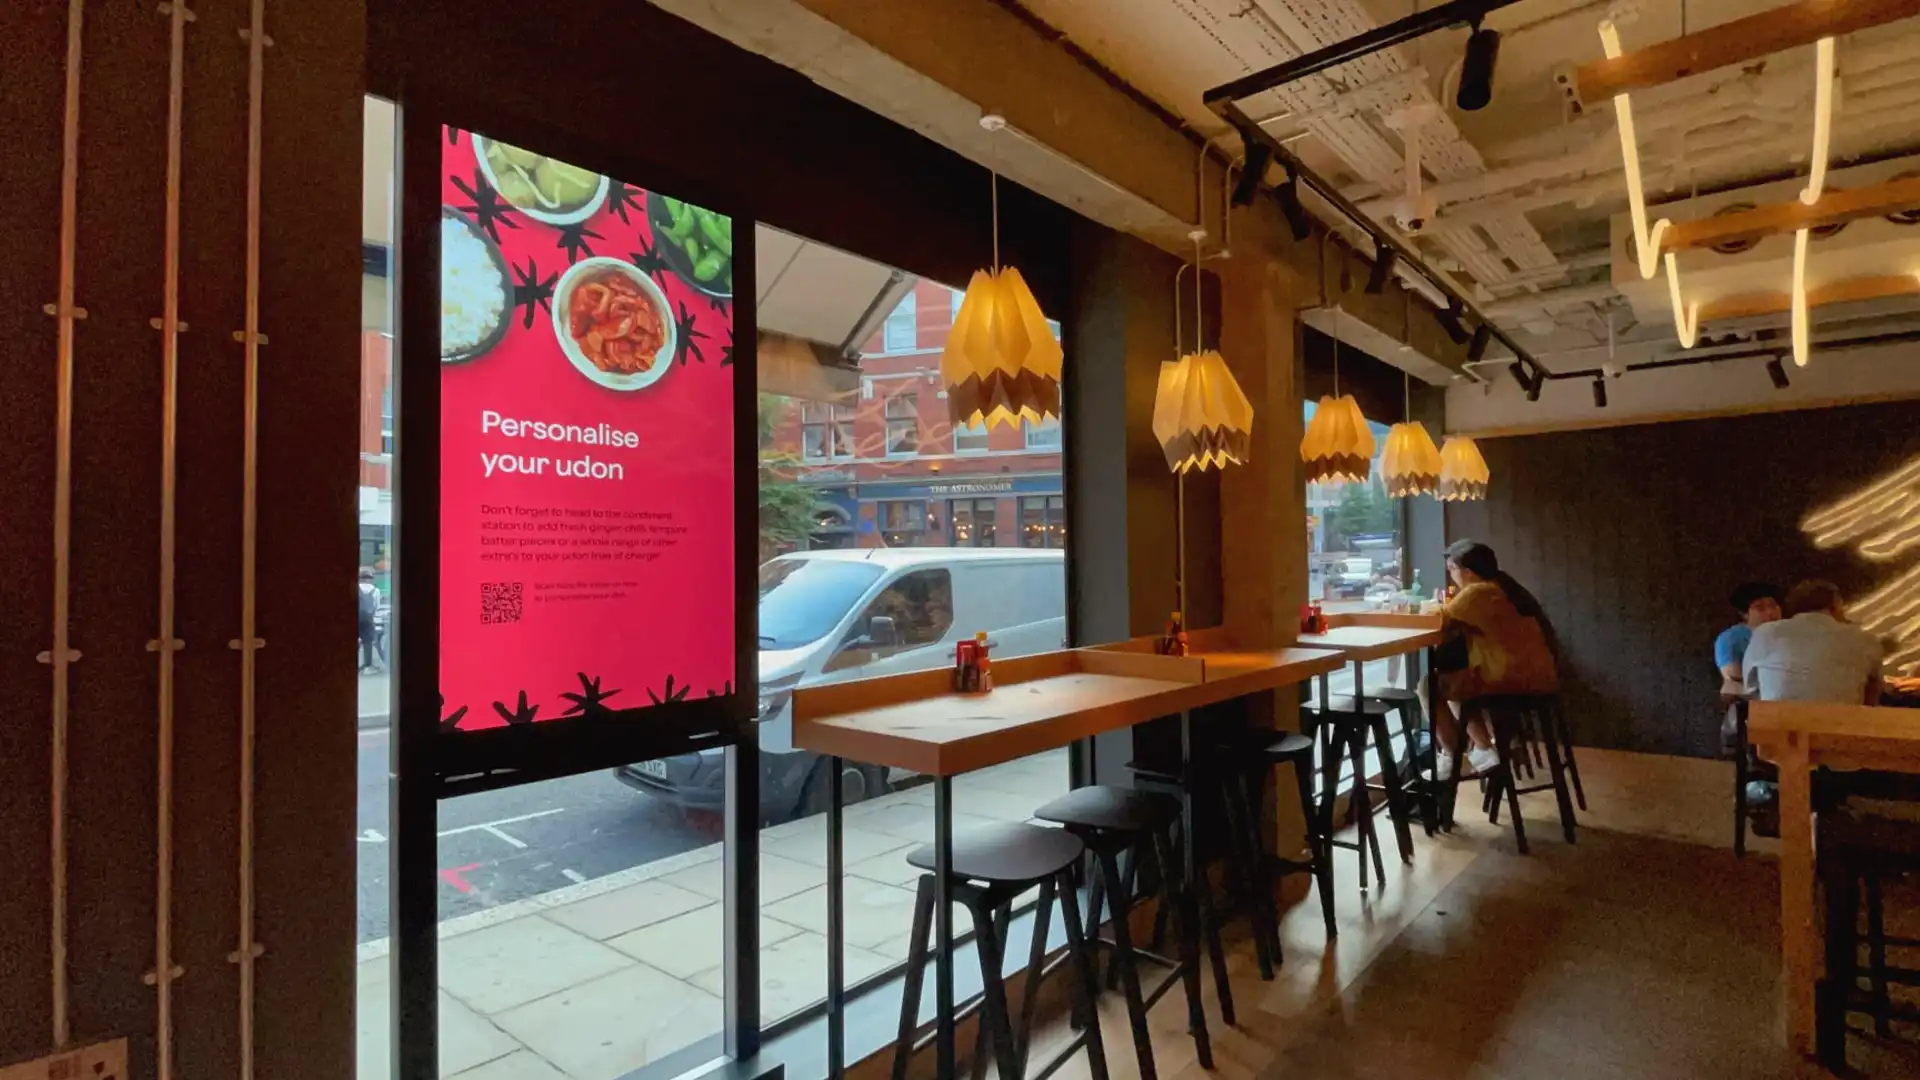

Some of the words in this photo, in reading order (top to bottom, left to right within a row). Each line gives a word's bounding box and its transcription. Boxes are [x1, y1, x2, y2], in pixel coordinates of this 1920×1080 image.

[482, 409, 639, 448] Personalise
[480, 452, 550, 478] your
[556, 455, 623, 480] udon
[930, 485, 948, 493] THE
[951, 483, 1013, 493] ASTRONOMER
[481, 504, 512, 515] Don't
[514, 504, 548, 518] forget
[552, 507, 563, 517] to
[593, 509, 603, 518] to
[605, 509, 621, 518] the
[481, 520, 520, 530] station
[523, 521, 534, 531] to
[537, 522, 558, 532] add
[481, 535, 515, 546] batter
[520, 552, 533, 561] to
[534, 553, 560, 563] your
